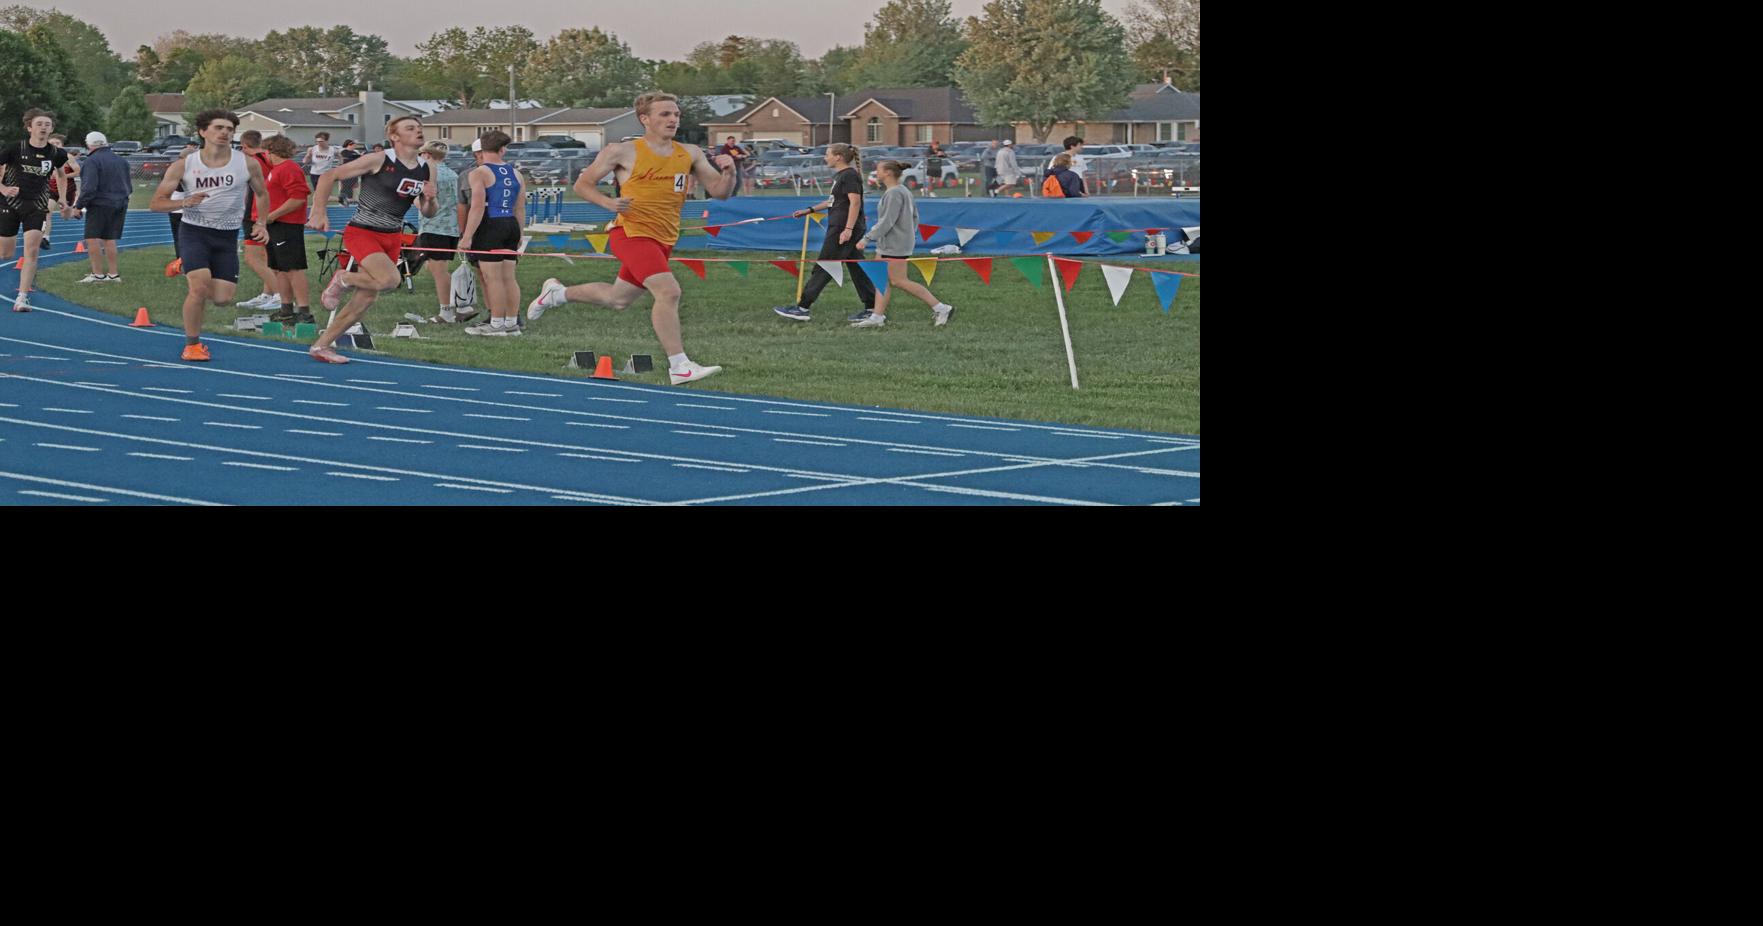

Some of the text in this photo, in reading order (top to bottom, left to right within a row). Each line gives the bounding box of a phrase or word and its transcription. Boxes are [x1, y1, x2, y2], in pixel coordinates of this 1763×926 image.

[44, 161, 50, 171] 3
[413, 182, 423, 195] 5
[675, 175, 683, 189] 4
